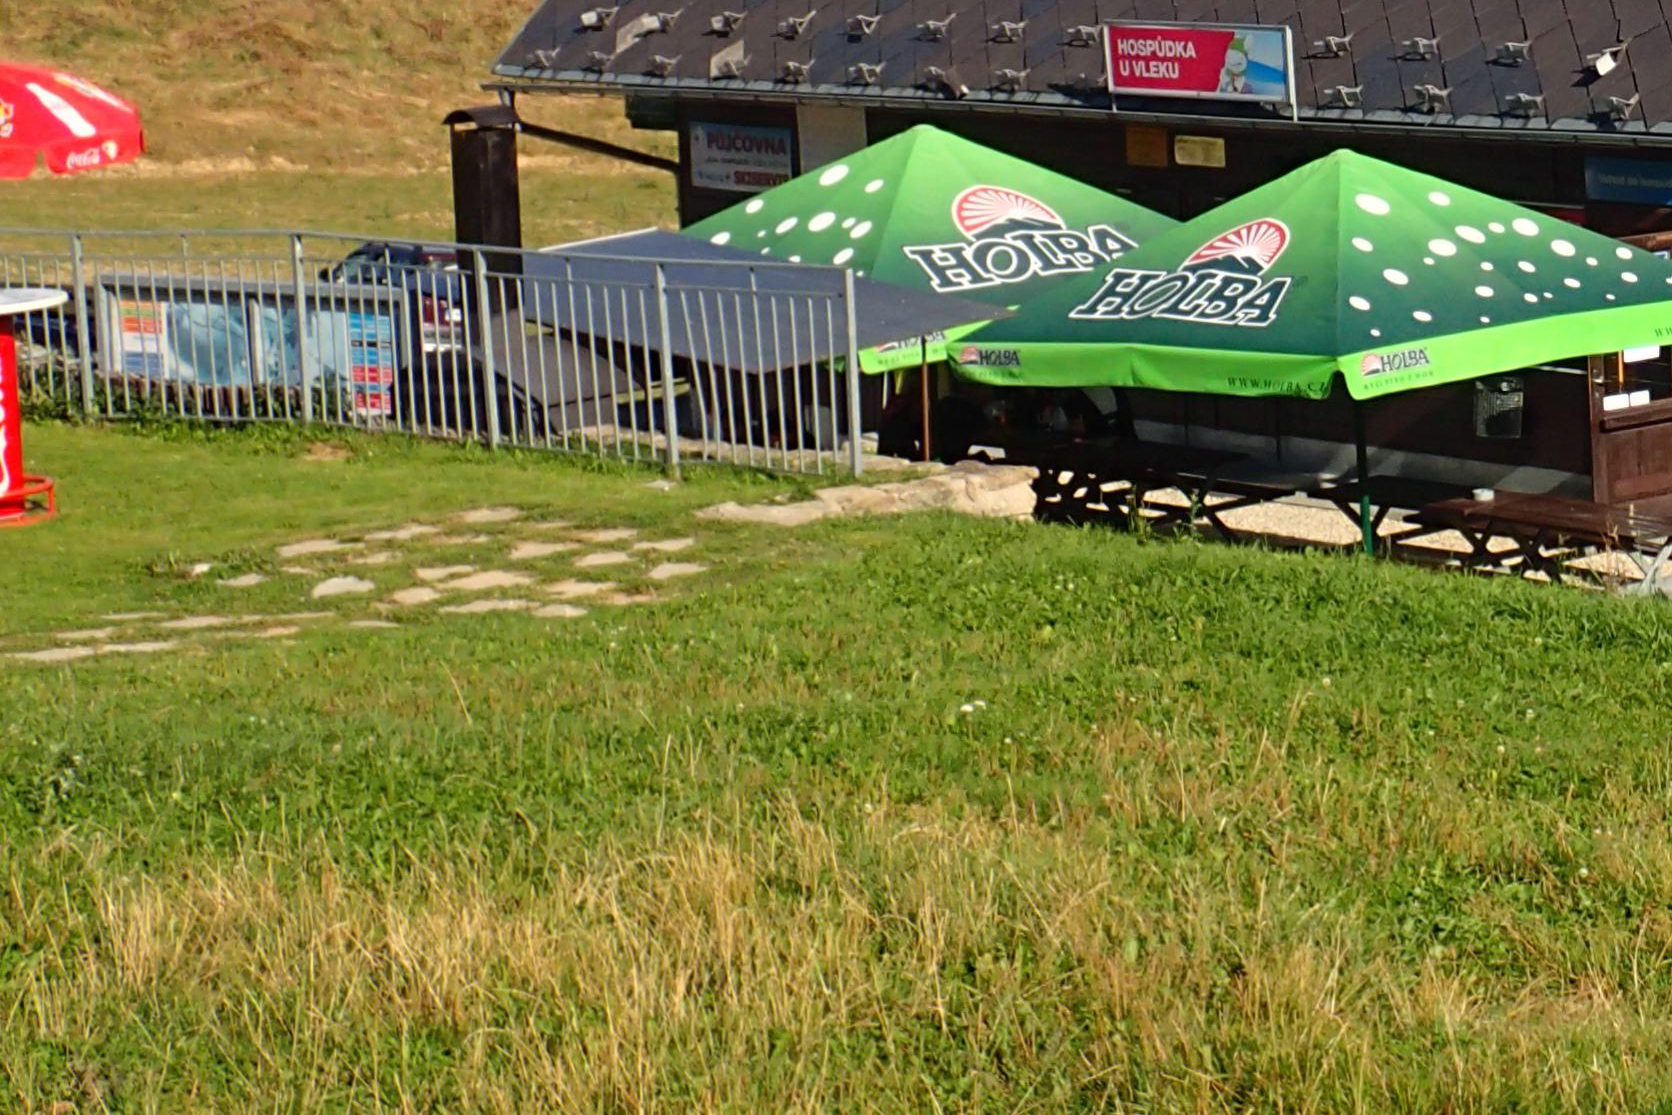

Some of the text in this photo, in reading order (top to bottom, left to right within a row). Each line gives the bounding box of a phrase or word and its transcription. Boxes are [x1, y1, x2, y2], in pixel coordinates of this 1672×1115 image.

[1117, 35, 1196, 59] HOSPŮDKA
[1119, 59, 1180, 79] U VLEKU
[902, 224, 1140, 293] HOLBA
[1068, 267, 1293, 327] HOLBA
[979, 349, 1021, 367] HOLBA
[1380, 348, 1430, 374] HOLBA
